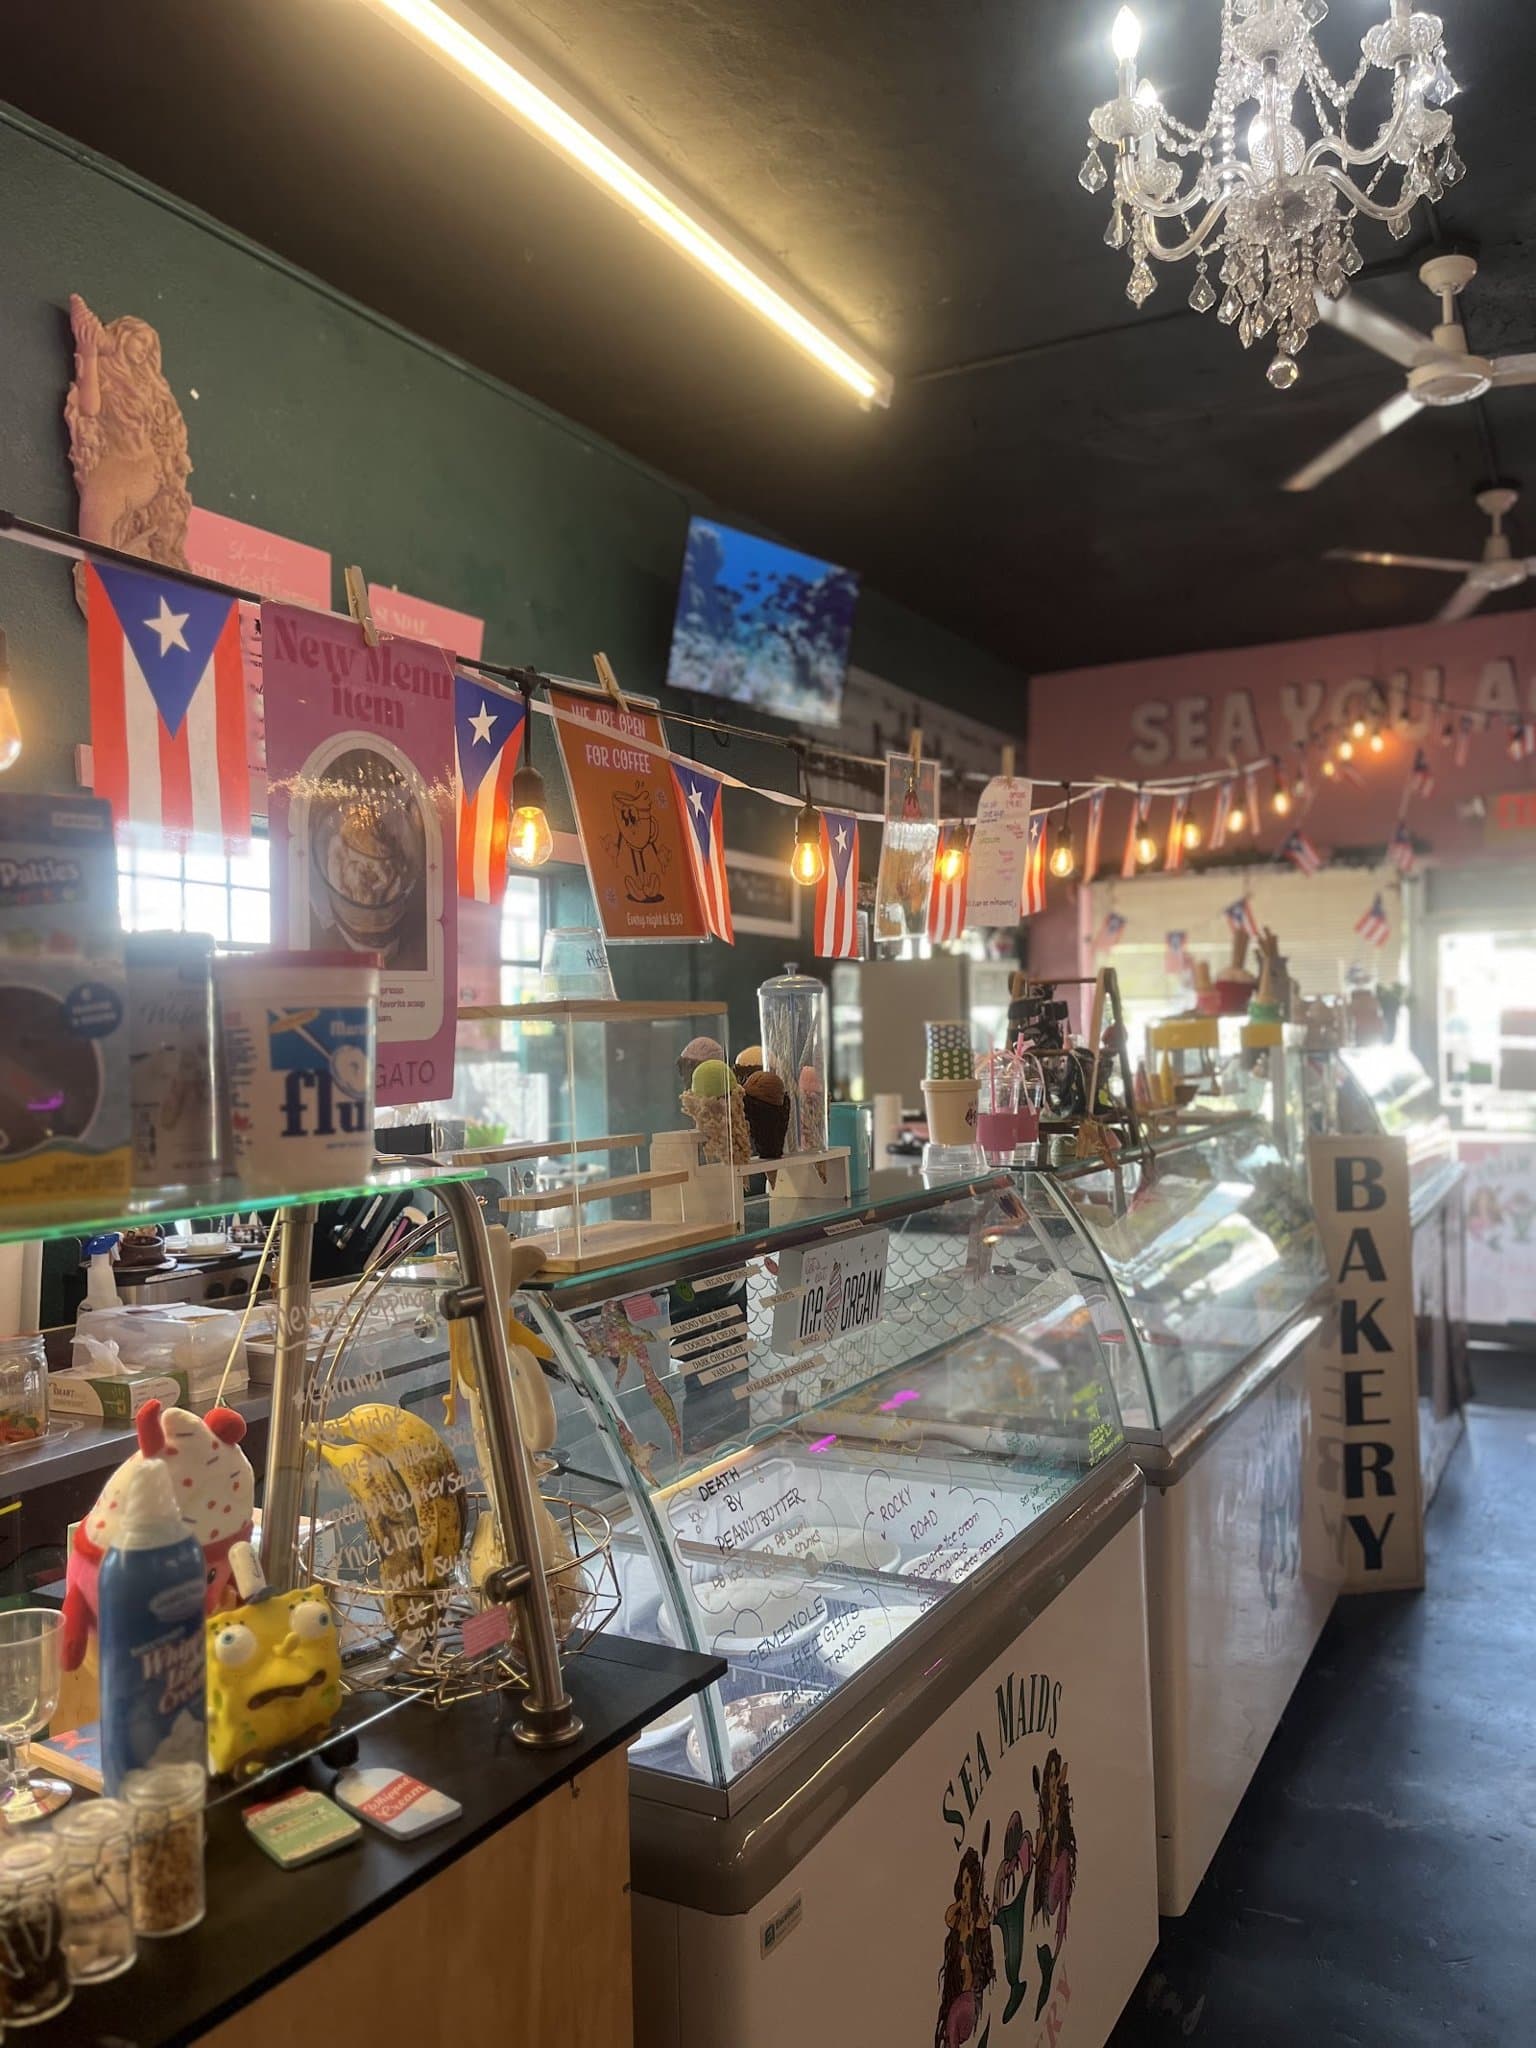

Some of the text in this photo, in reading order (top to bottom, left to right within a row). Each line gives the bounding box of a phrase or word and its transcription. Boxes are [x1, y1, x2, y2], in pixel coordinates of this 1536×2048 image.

[272, 616, 452, 702] New Menu
[594, 710, 616, 730] ARE
[618, 712, 647, 738] OPEN
[1130, 655, 1536, 767] SEA YOU A
[586, 744, 651, 774] FOR COFFEE
[672, 1320, 699, 1333] ALMOND
[699, 1314, 714, 1326] MILK
[683, 1337, 708, 1352] COOKIES
[716, 1328, 738, 1342] CREAM
[692, 1345, 746, 1370] DARK CHOCOLATE
[711, 1362, 737, 1378] VANILLA
[1333, 1155, 1397, 1571] BAKERY
[697, 1466, 741, 1502] DEATH
[723, 1491, 744, 1513] BY
[879, 1484, 912, 1523] ROCKY
[909, 1509, 938, 1544] ROAD
[749, 1594, 827, 1671] SEMINOLE
[791, 1602, 860, 1670] HEIGHTS
[823, 1624, 868, 1669] TRACKS
[942, 1671, 1063, 1853] SEA MAIDS
[363, 1776, 410, 1813] Whipped
[375, 1784, 427, 1817] Cream
